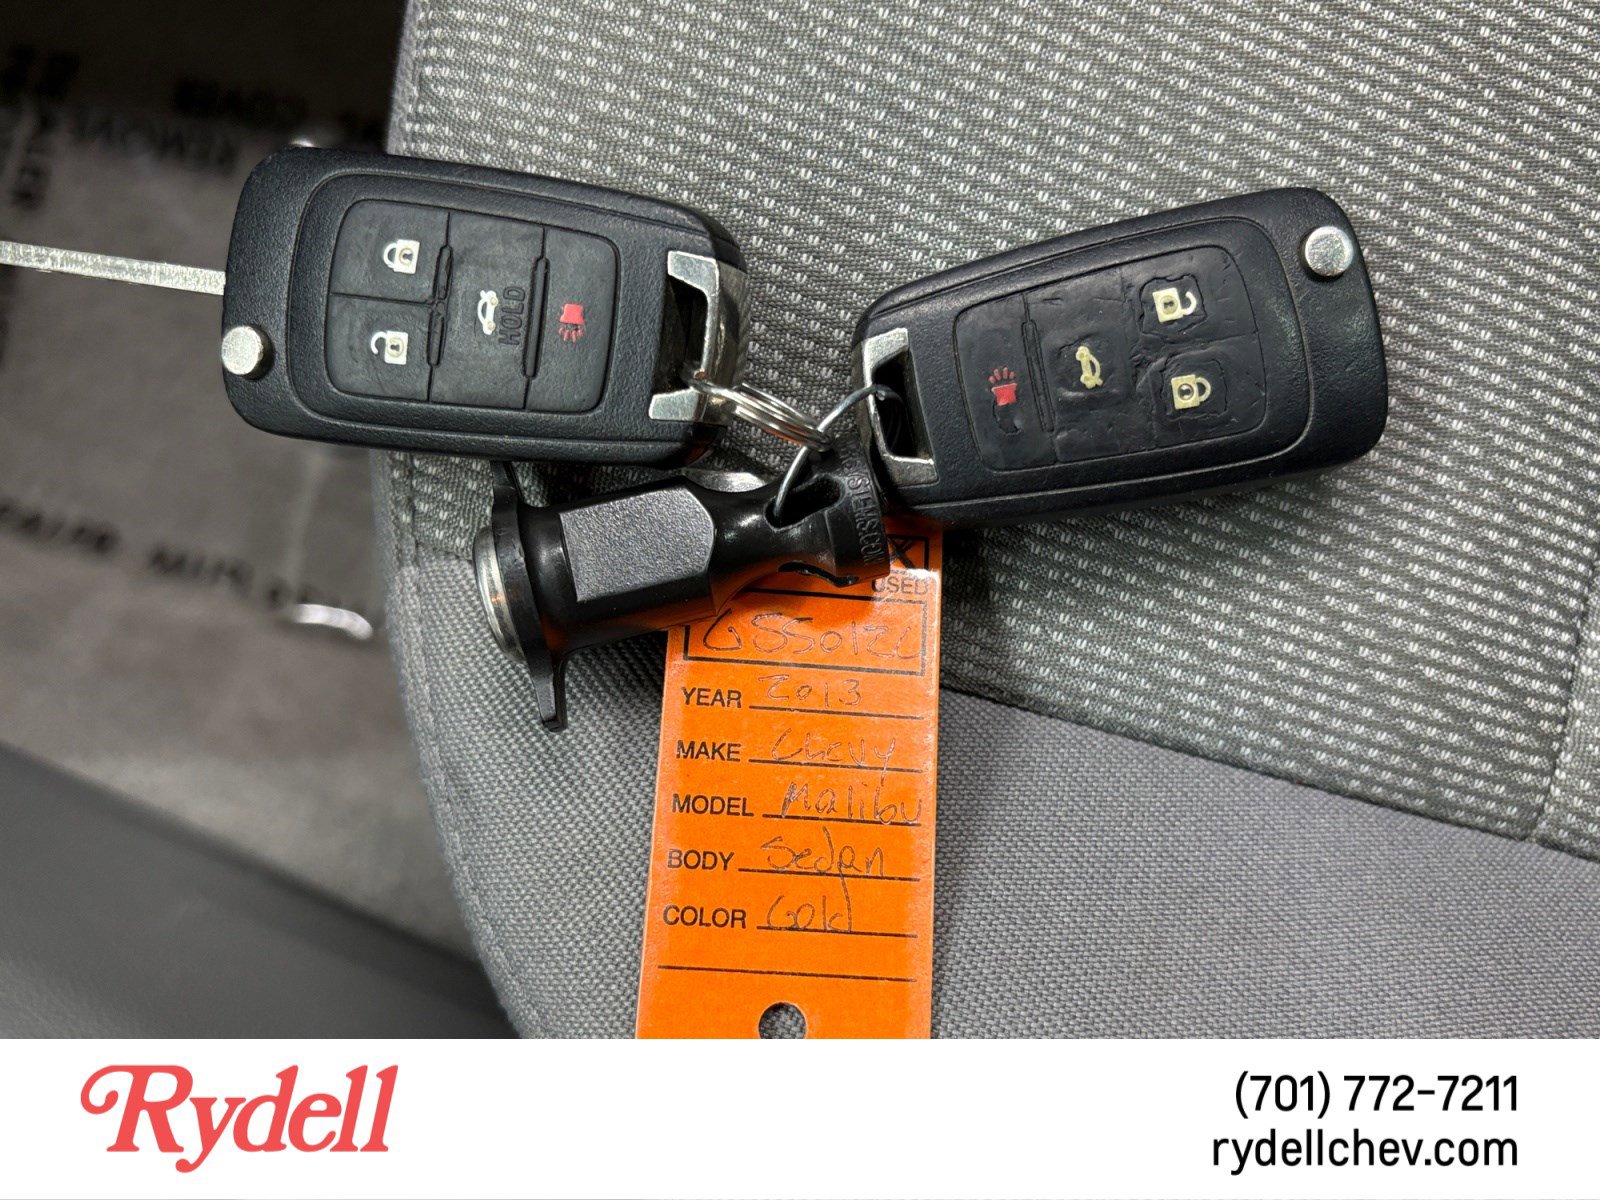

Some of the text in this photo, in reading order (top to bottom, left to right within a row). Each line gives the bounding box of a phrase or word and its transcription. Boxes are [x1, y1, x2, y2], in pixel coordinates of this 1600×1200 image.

[497, 286, 526, 346] HOLD
[872, 576, 929, 595] USED
[681, 674, 861, 708] YEAR 2013
[676, 740, 741, 762] MAKE
[672, 782, 923, 825] MODEL Malibu
[667, 849, 734, 871] BODY
[663, 889, 852, 933] COLOR Gold
